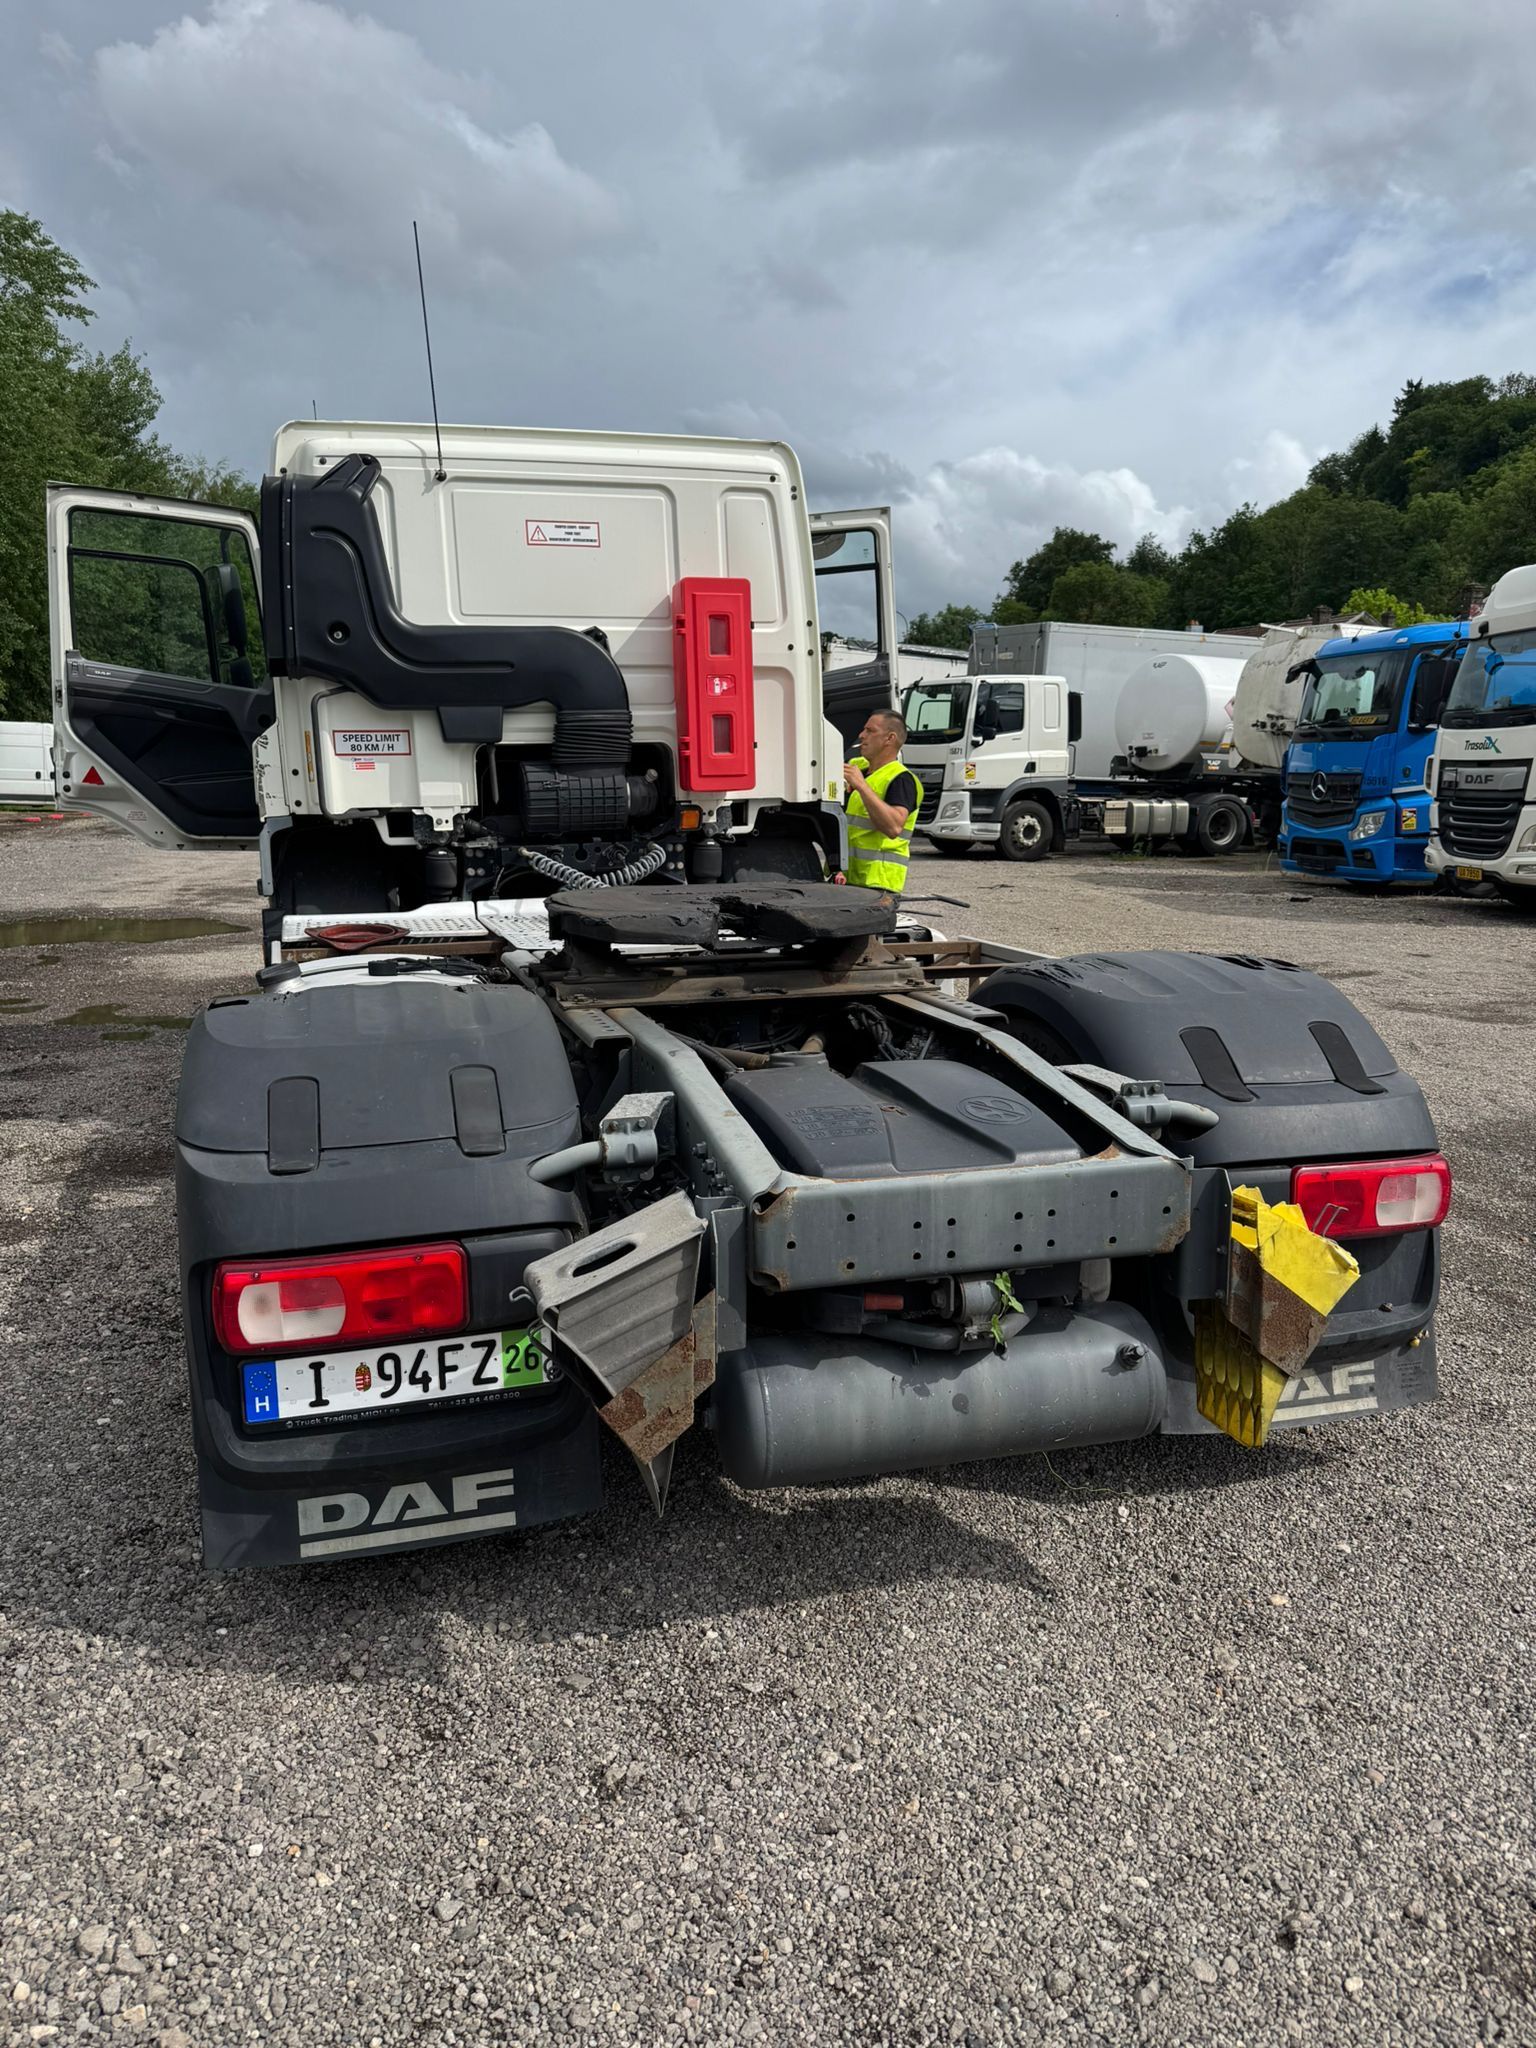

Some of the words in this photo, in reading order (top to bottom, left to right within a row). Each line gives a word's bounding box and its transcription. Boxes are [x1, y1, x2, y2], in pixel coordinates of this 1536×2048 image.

[342, 733, 373, 742] SPEED
[375, 733, 401, 742] LIMIT
[350, 743, 363, 752] 80
[364, 743, 380, 752] KM
[387, 743, 395, 752] H
[1464, 774, 1495, 784] DAF
[308, 1360, 330, 1408] I
[377, 1339, 499, 1399] 94FZ
[505, 1343, 540, 1374] 26
[1278, 1360, 1376, 1402] AF
[255, 1396, 270, 1413] H
[295, 1417, 322, 1427] Truck
[324, 1412, 359, 1423] Trading
[296, 1468, 515, 1536] DAF
